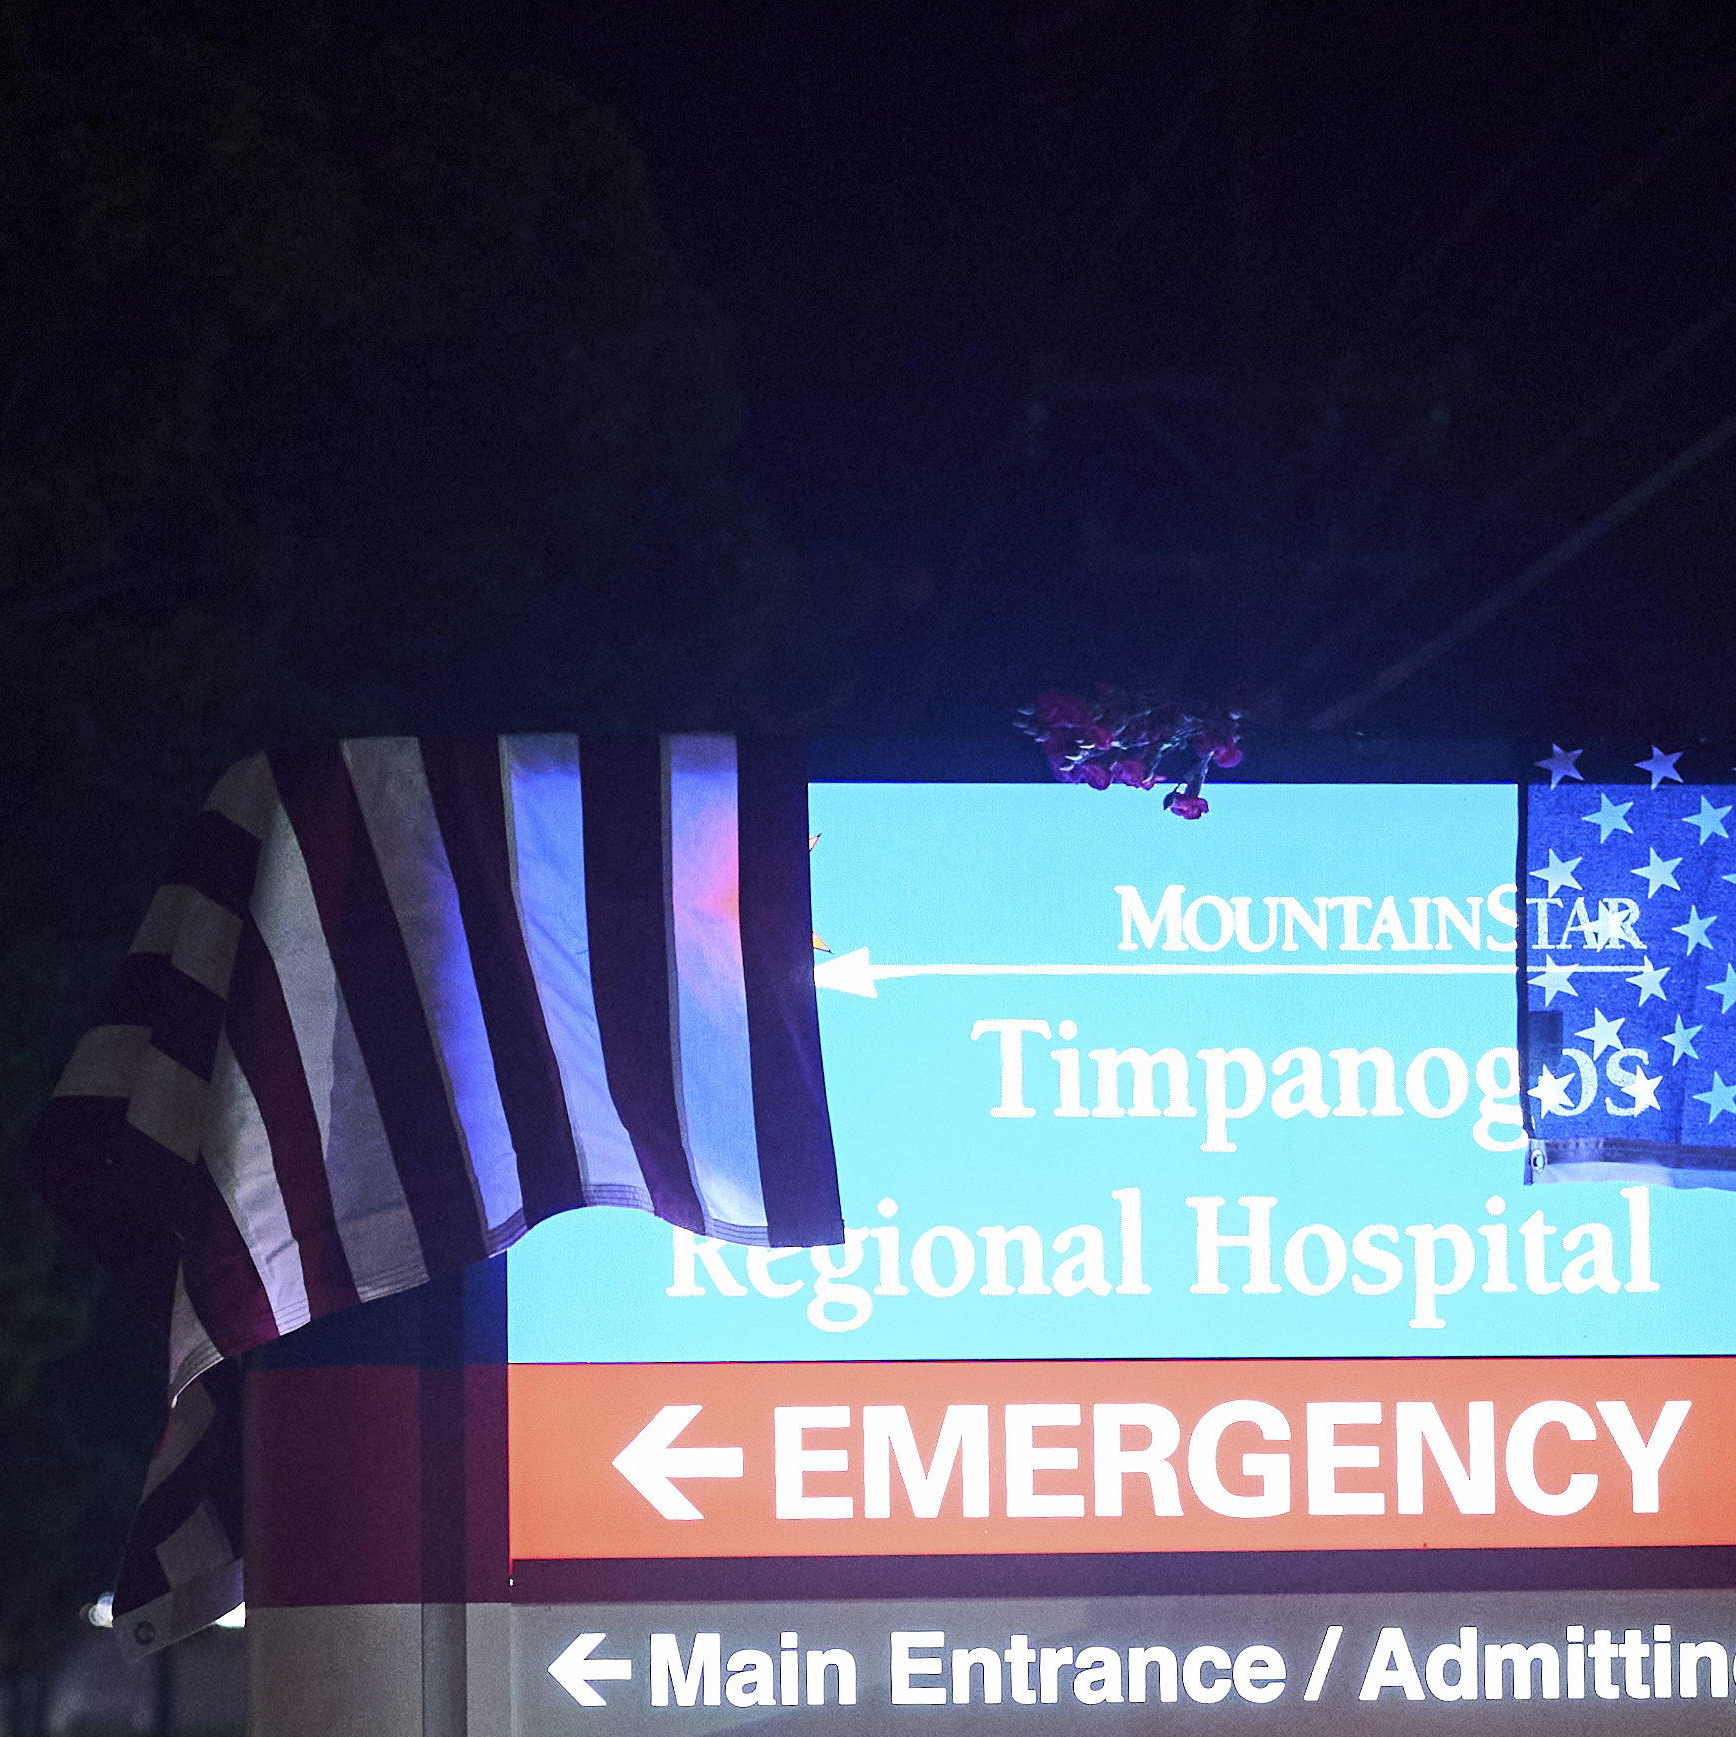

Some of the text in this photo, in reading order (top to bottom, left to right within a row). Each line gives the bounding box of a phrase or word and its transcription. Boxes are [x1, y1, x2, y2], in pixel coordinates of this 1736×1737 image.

[969, 1018, 1651, 1153] Timpanogos
[664, 1186, 1661, 1333] Regional Hospital
[773, 1399, 1693, 1520] EMERGENCY
[650, 1631, 857, 1708] Main
[890, 1631, 1287, 1705] Entrance
[1303, 1625, 1343, 1701] /
